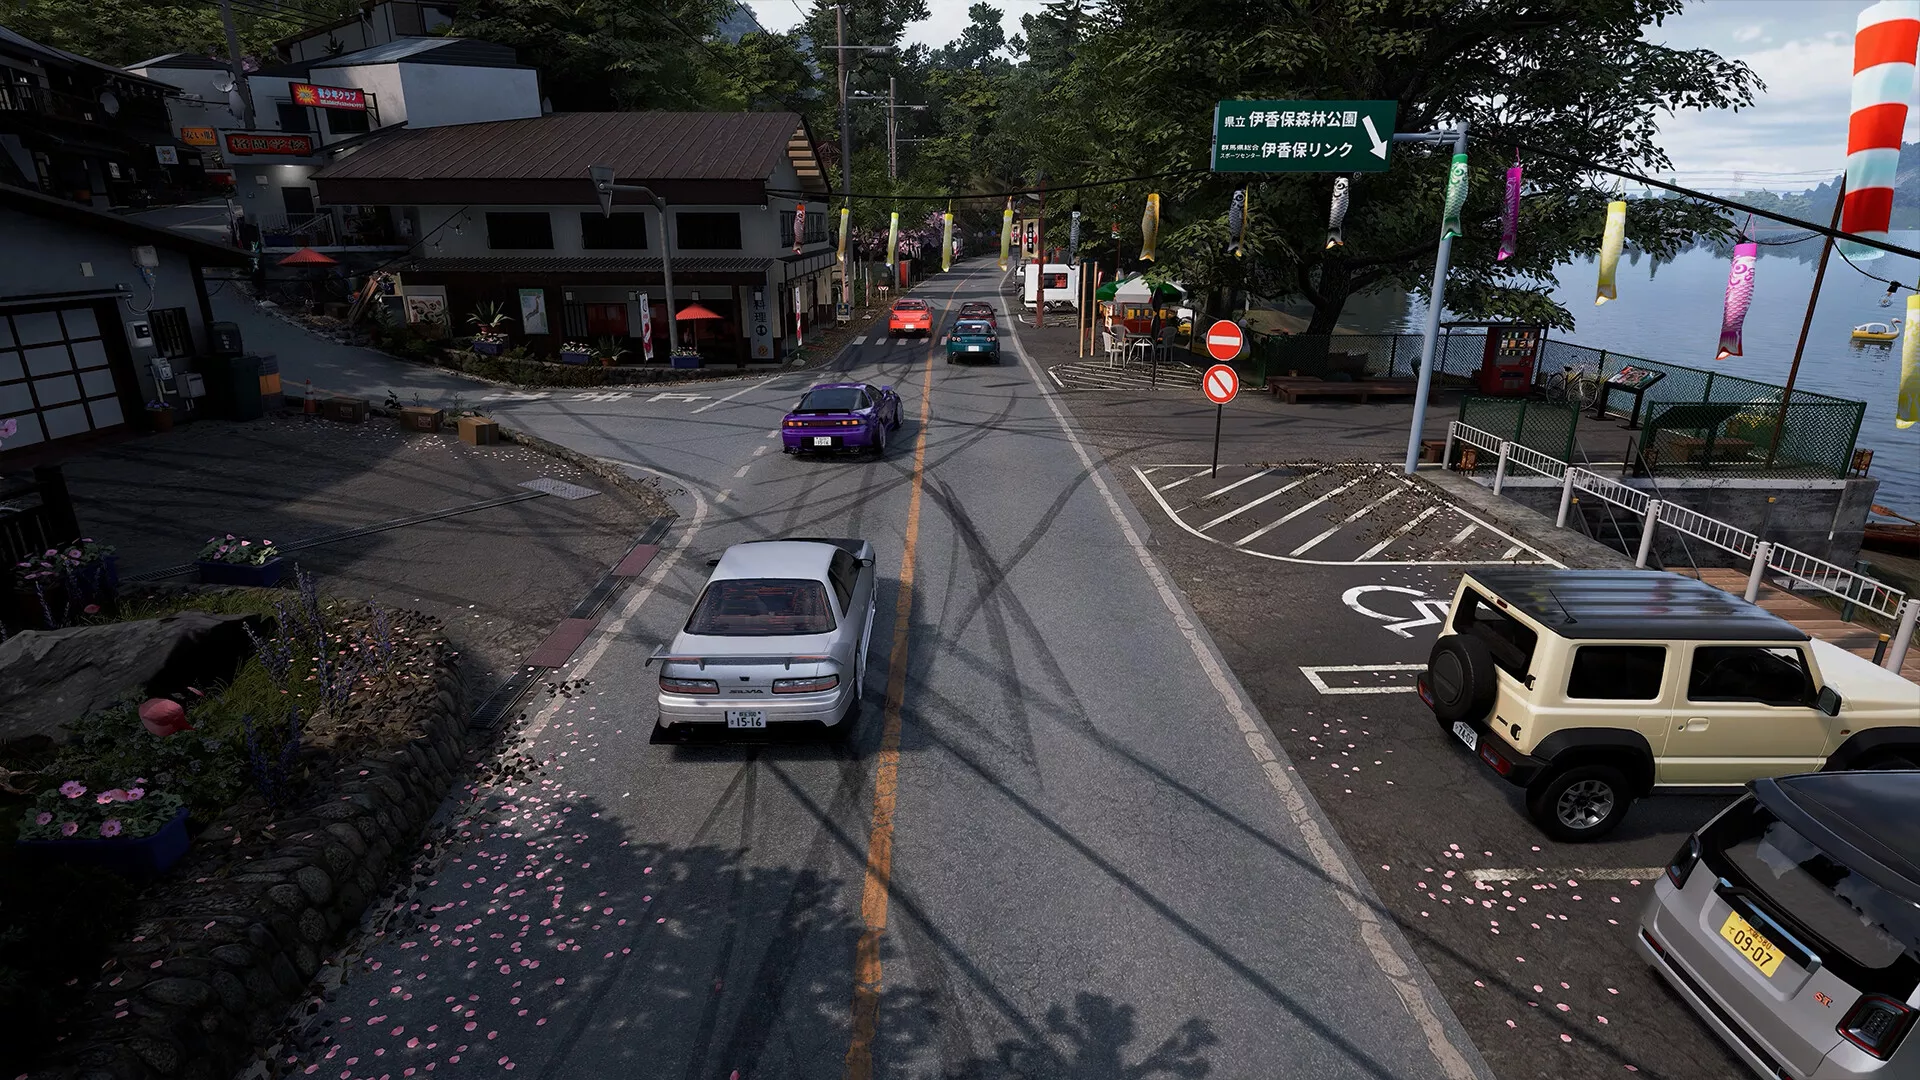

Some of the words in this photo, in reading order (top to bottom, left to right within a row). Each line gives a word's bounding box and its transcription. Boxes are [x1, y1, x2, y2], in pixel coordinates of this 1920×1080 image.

[1224, 116, 1246, 128] 県立
[1249, 111, 1358, 128] 伊香保森林公園
[232, 138, 306, 151] 格闘学校
[1261, 142, 1353, 158] 伊香保リンク
[737, 717, 762, 726] 15-16
[1733, 930, 1773, 967] 09-07
